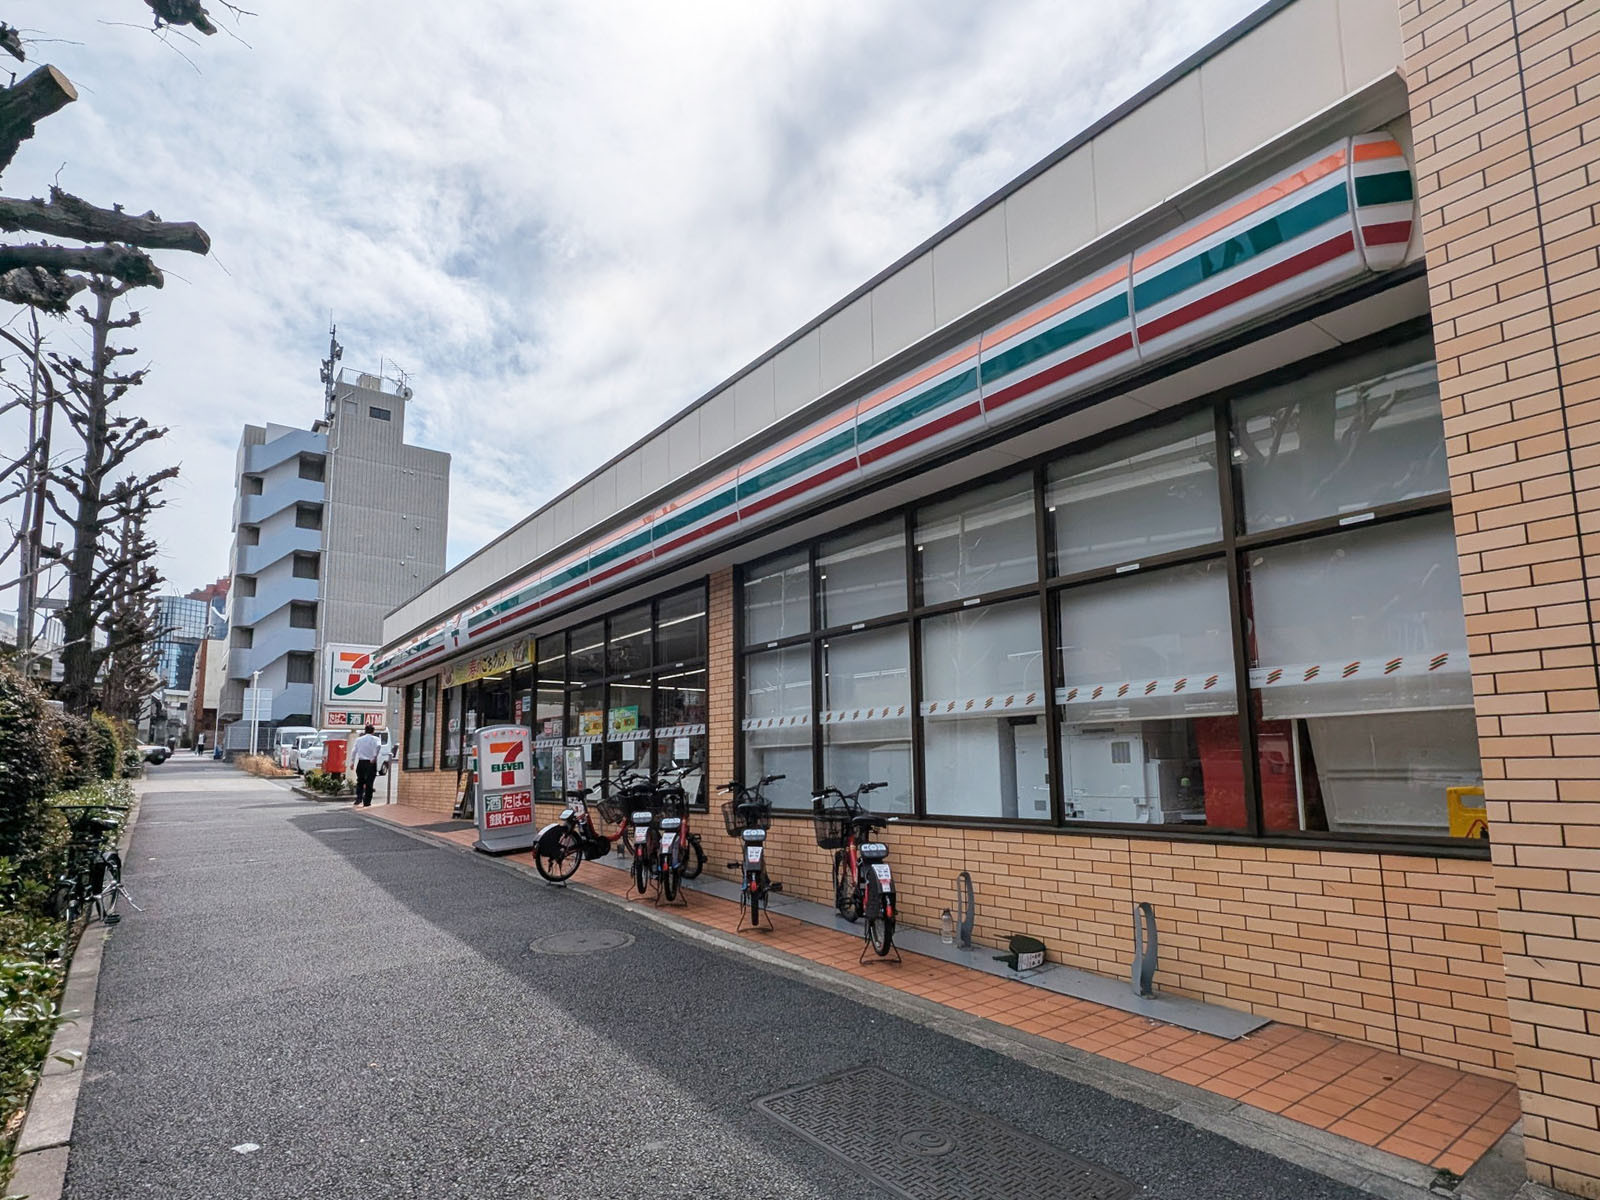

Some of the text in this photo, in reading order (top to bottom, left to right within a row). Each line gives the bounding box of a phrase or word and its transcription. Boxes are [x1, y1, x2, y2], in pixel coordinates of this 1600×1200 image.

[329, 713, 382, 725] たばこ 酒 ATM
[487, 793, 531, 811] 酒 たばこ
